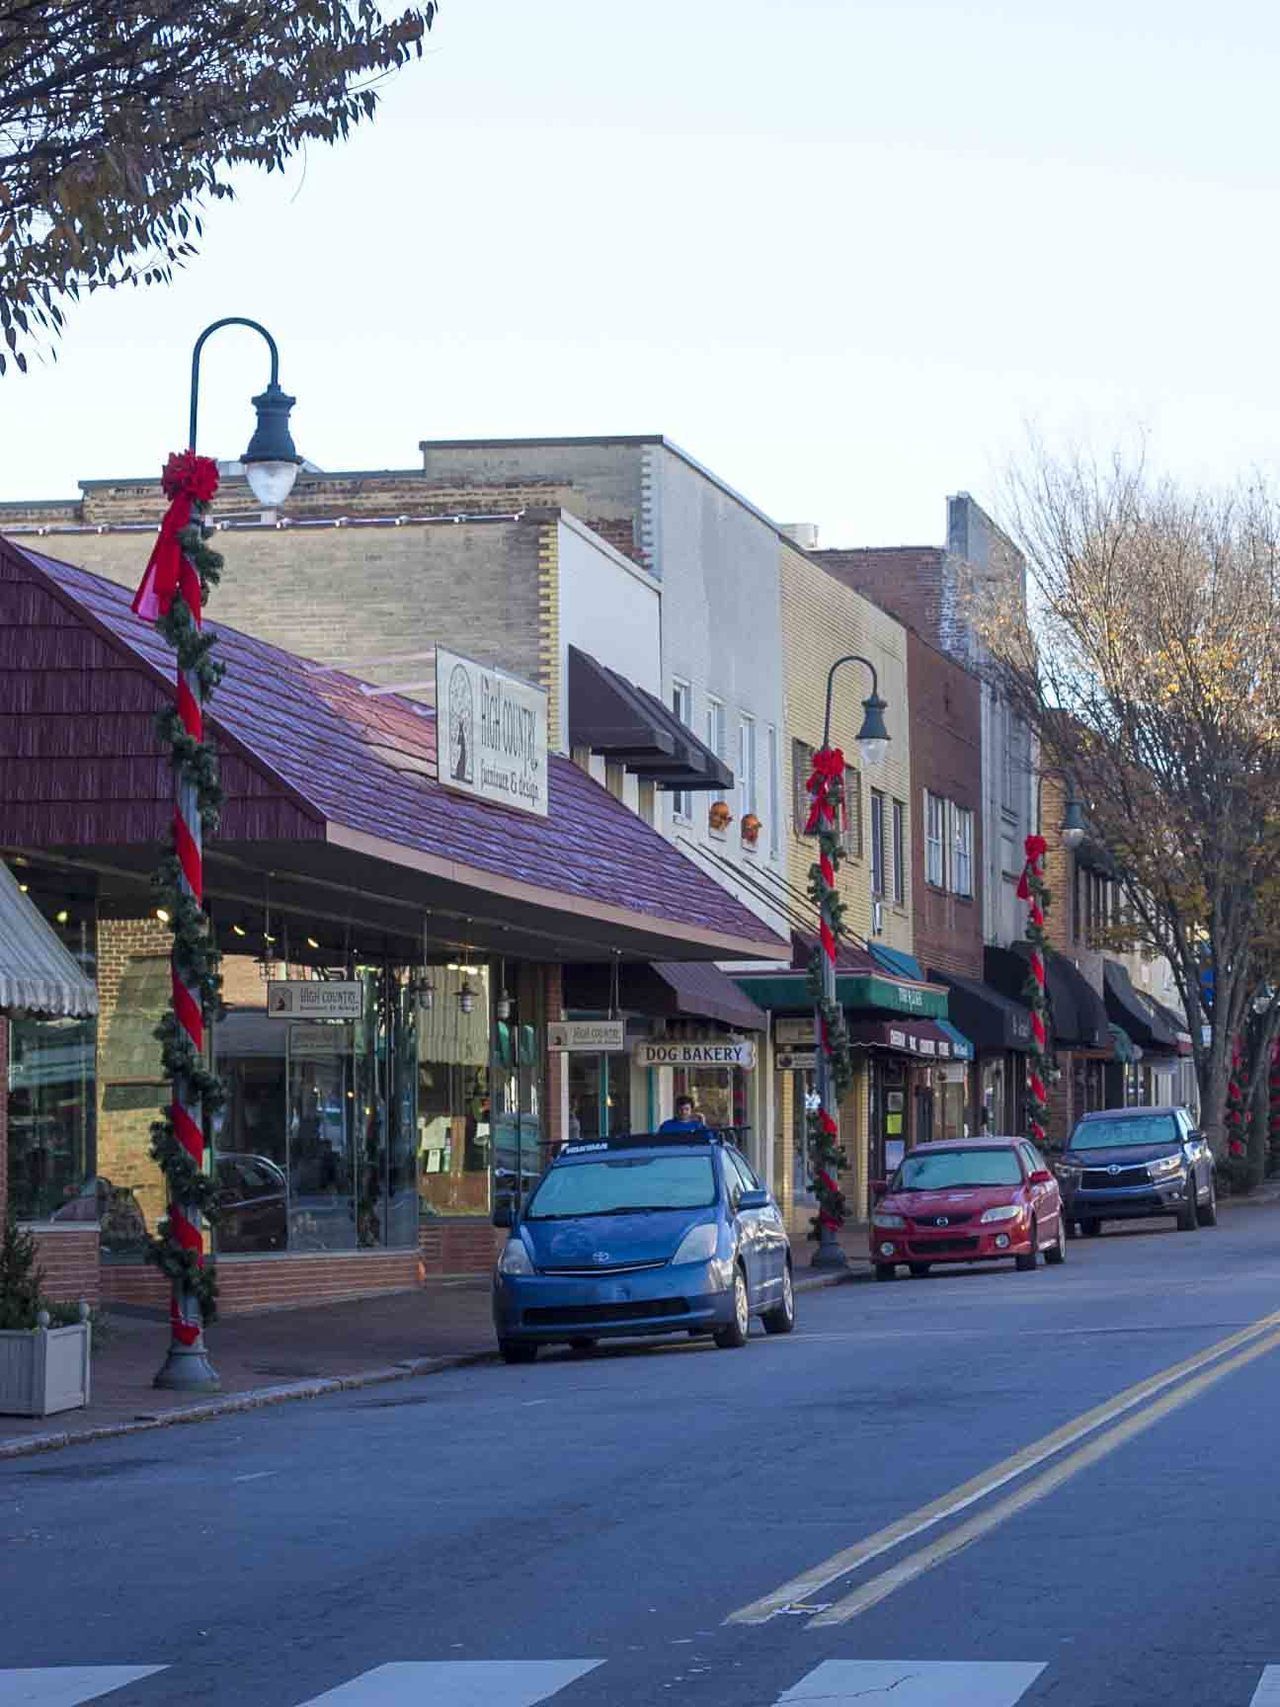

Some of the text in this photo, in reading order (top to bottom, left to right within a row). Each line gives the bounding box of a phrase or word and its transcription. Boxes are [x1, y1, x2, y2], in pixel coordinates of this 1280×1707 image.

[502, 698, 538, 778] COUNTRY
[510, 771, 518, 794] &
[322, 990, 359, 1004] COUNTRY
[646, 1047, 742, 1060] DOG BAKERY
